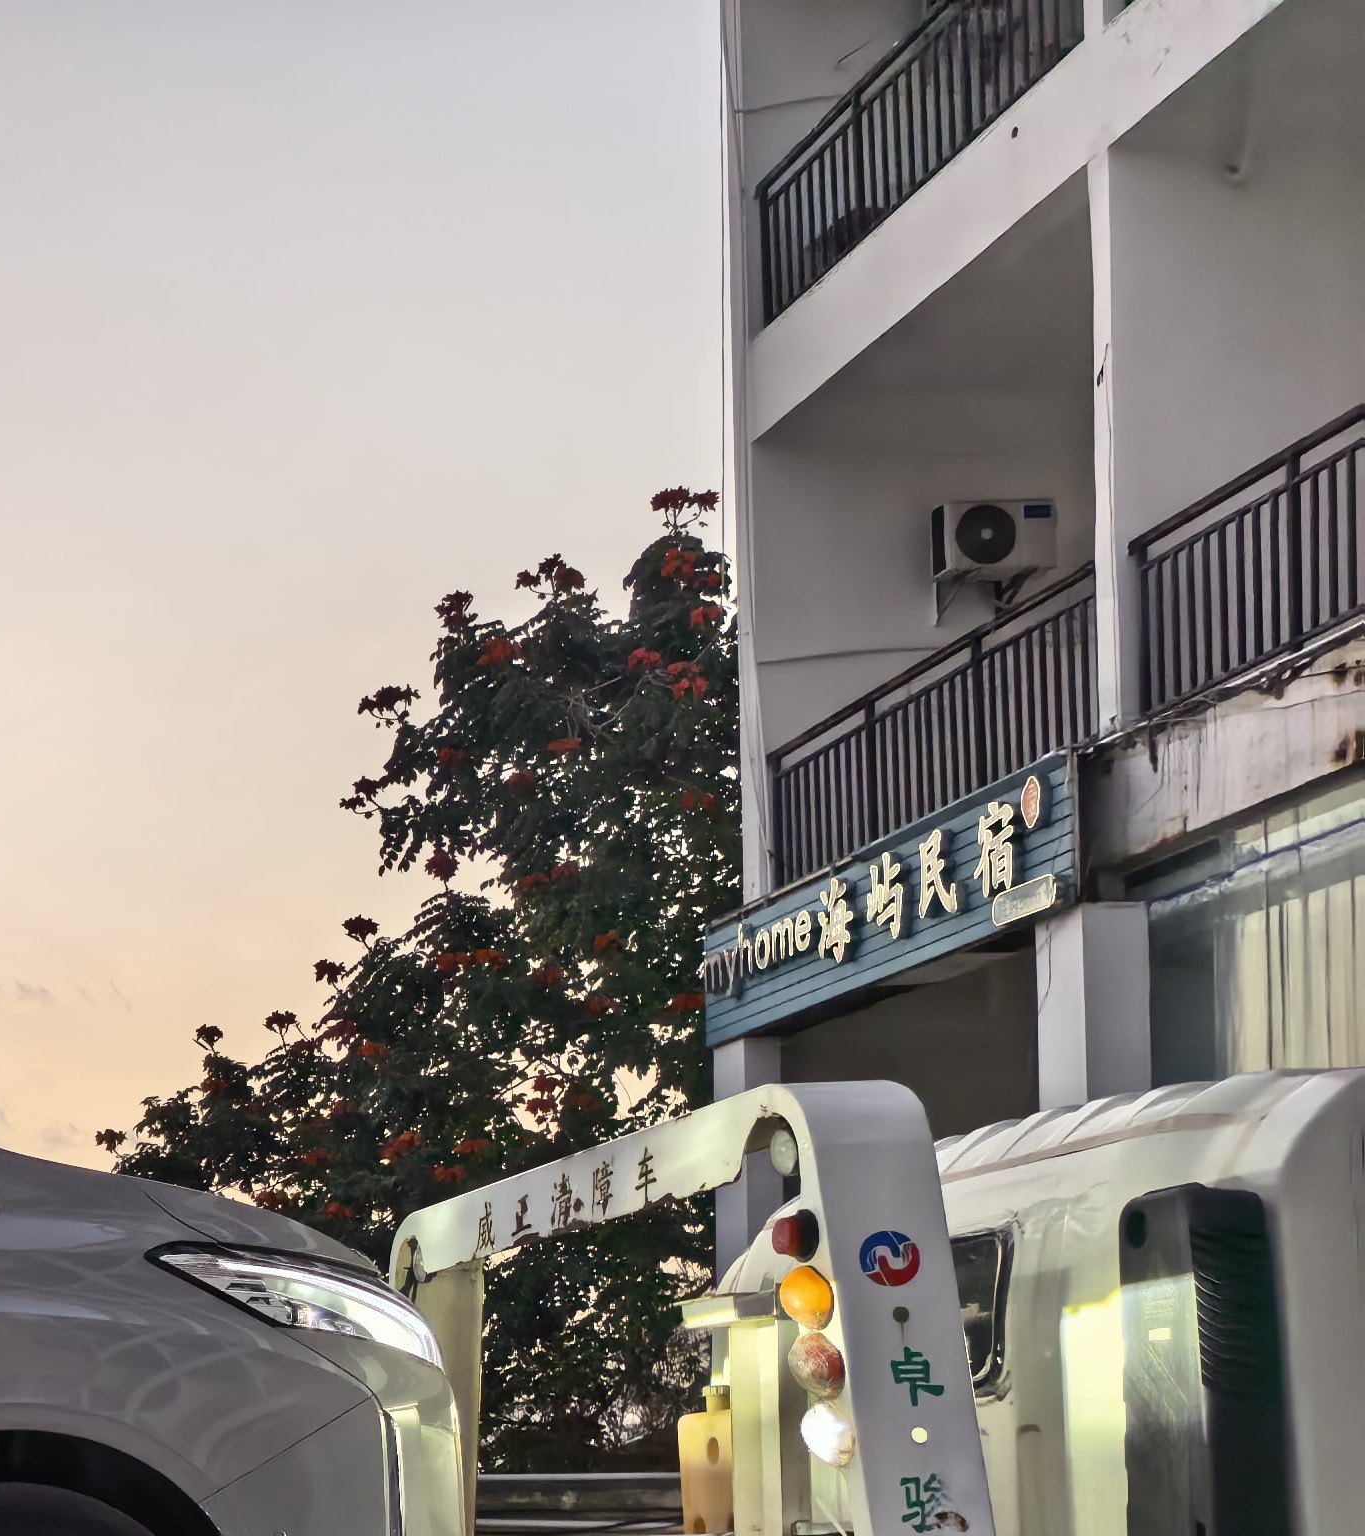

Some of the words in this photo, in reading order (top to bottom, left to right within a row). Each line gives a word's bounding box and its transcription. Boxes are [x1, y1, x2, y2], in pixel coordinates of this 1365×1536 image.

[704, 908, 812, 998] myhome
[817, 801, 1015, 965] 海屿民宿
